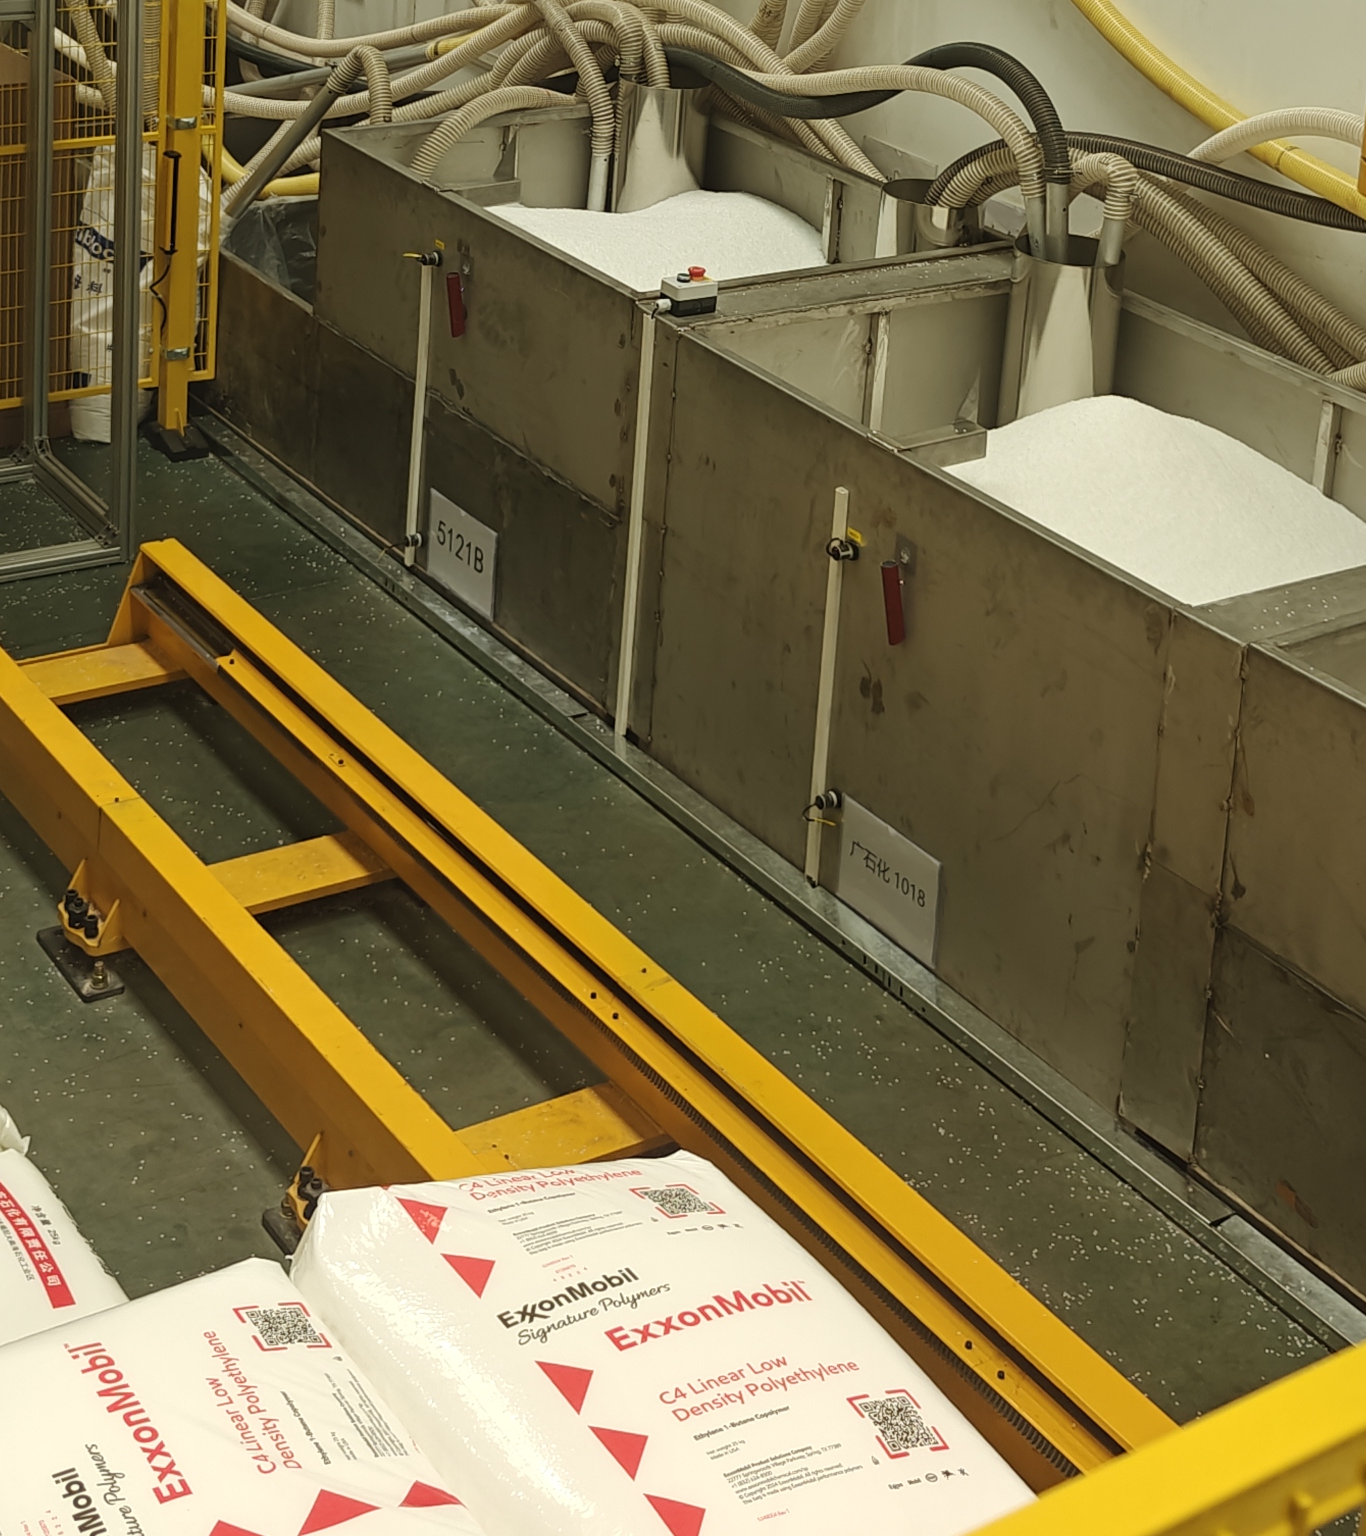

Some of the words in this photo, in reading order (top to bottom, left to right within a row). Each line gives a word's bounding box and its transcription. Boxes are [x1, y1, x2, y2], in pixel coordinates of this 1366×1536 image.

[437, 520, 484, 574] 5121B
[849, 840, 891, 885] 广石化
[893, 869, 927, 908] 1018
[469, 1182, 537, 1202] Density
[537, 1168, 644, 1190] Polyethylene
[485, 1172, 536, 1188] Linear
[496, 1267, 639, 1329] ExxonMobil
[517, 1306, 599, 1346] Signature
[598, 1282, 672, 1313] Polymers
[203, 1329, 268, 1415] Polyethylene
[205, 1376, 234, 1408] Low
[658, 1386, 688, 1406] C4
[687, 1367, 745, 1396] Linear
[746, 1355, 788, 1376] Low
[671, 1390, 746, 1423] Density
[744, 1359, 861, 1398] Polyethylene
[231, 1409, 266, 1452] Linear
[259, 1416, 303, 1470] Density
[693, 1427, 724, 1442] Ethylene
[725, 1416, 755, 1433] 1-Butene
[754, 1405, 791, 1422] Copolymer
[85, 1443, 127, 1506] Polymers
[250, 1452, 277, 1475] C4
